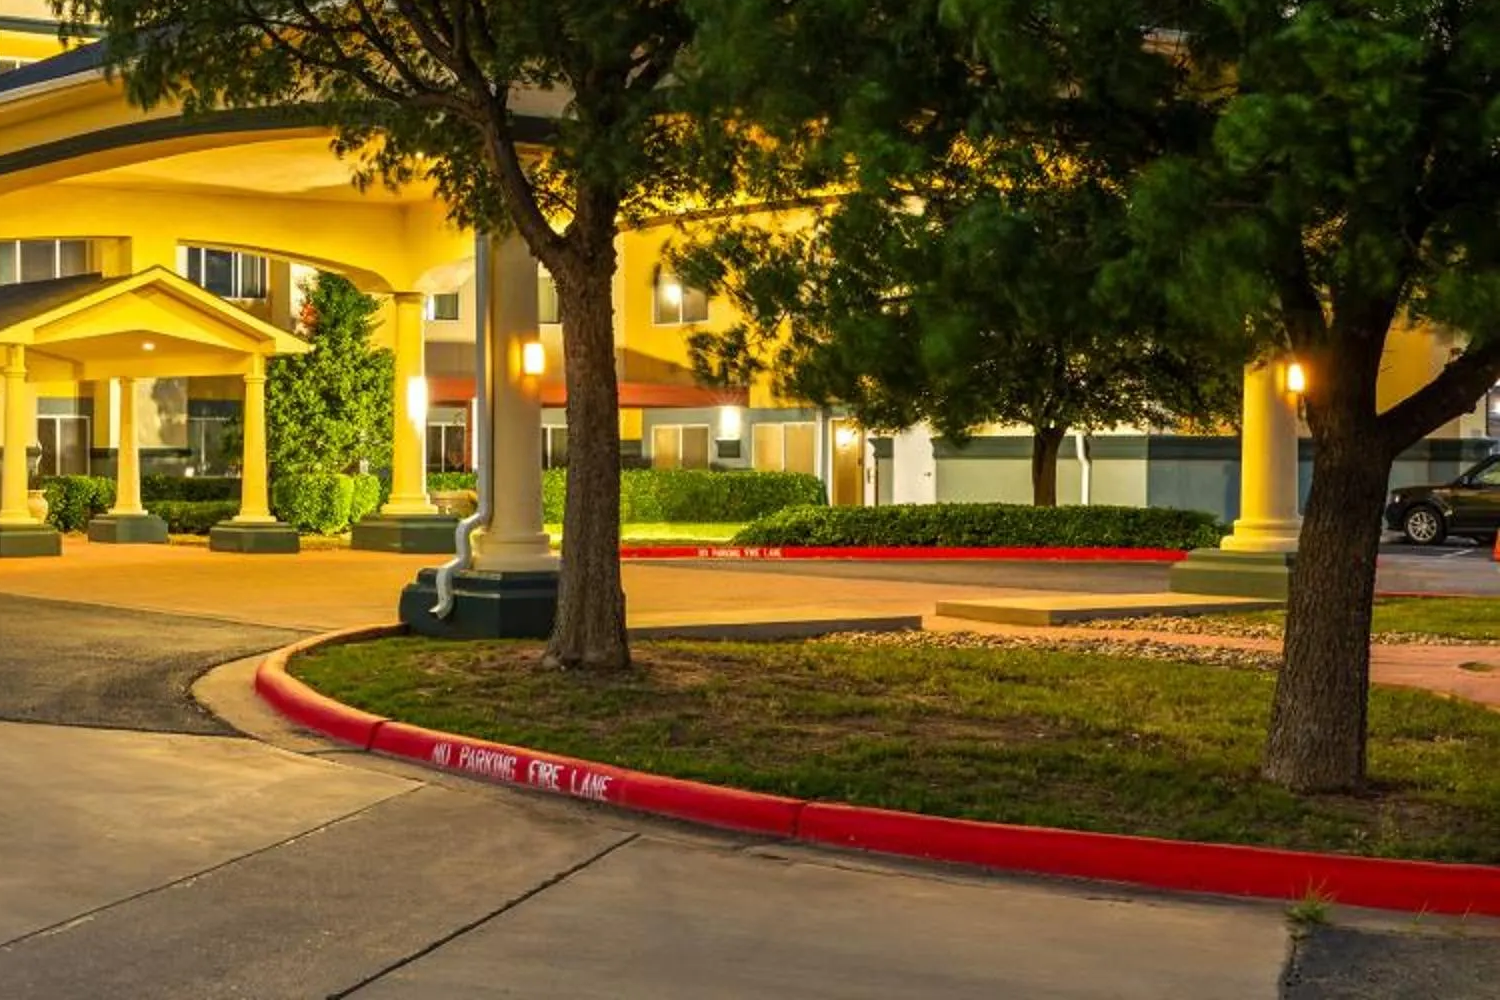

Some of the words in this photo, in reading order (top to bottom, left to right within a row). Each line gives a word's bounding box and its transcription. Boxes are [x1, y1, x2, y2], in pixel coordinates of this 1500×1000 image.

[433, 743, 451, 766] NO
[459, 745, 517, 781] PARKING
[528, 760, 564, 790] FIRE
[571, 769, 612, 800] LANE
